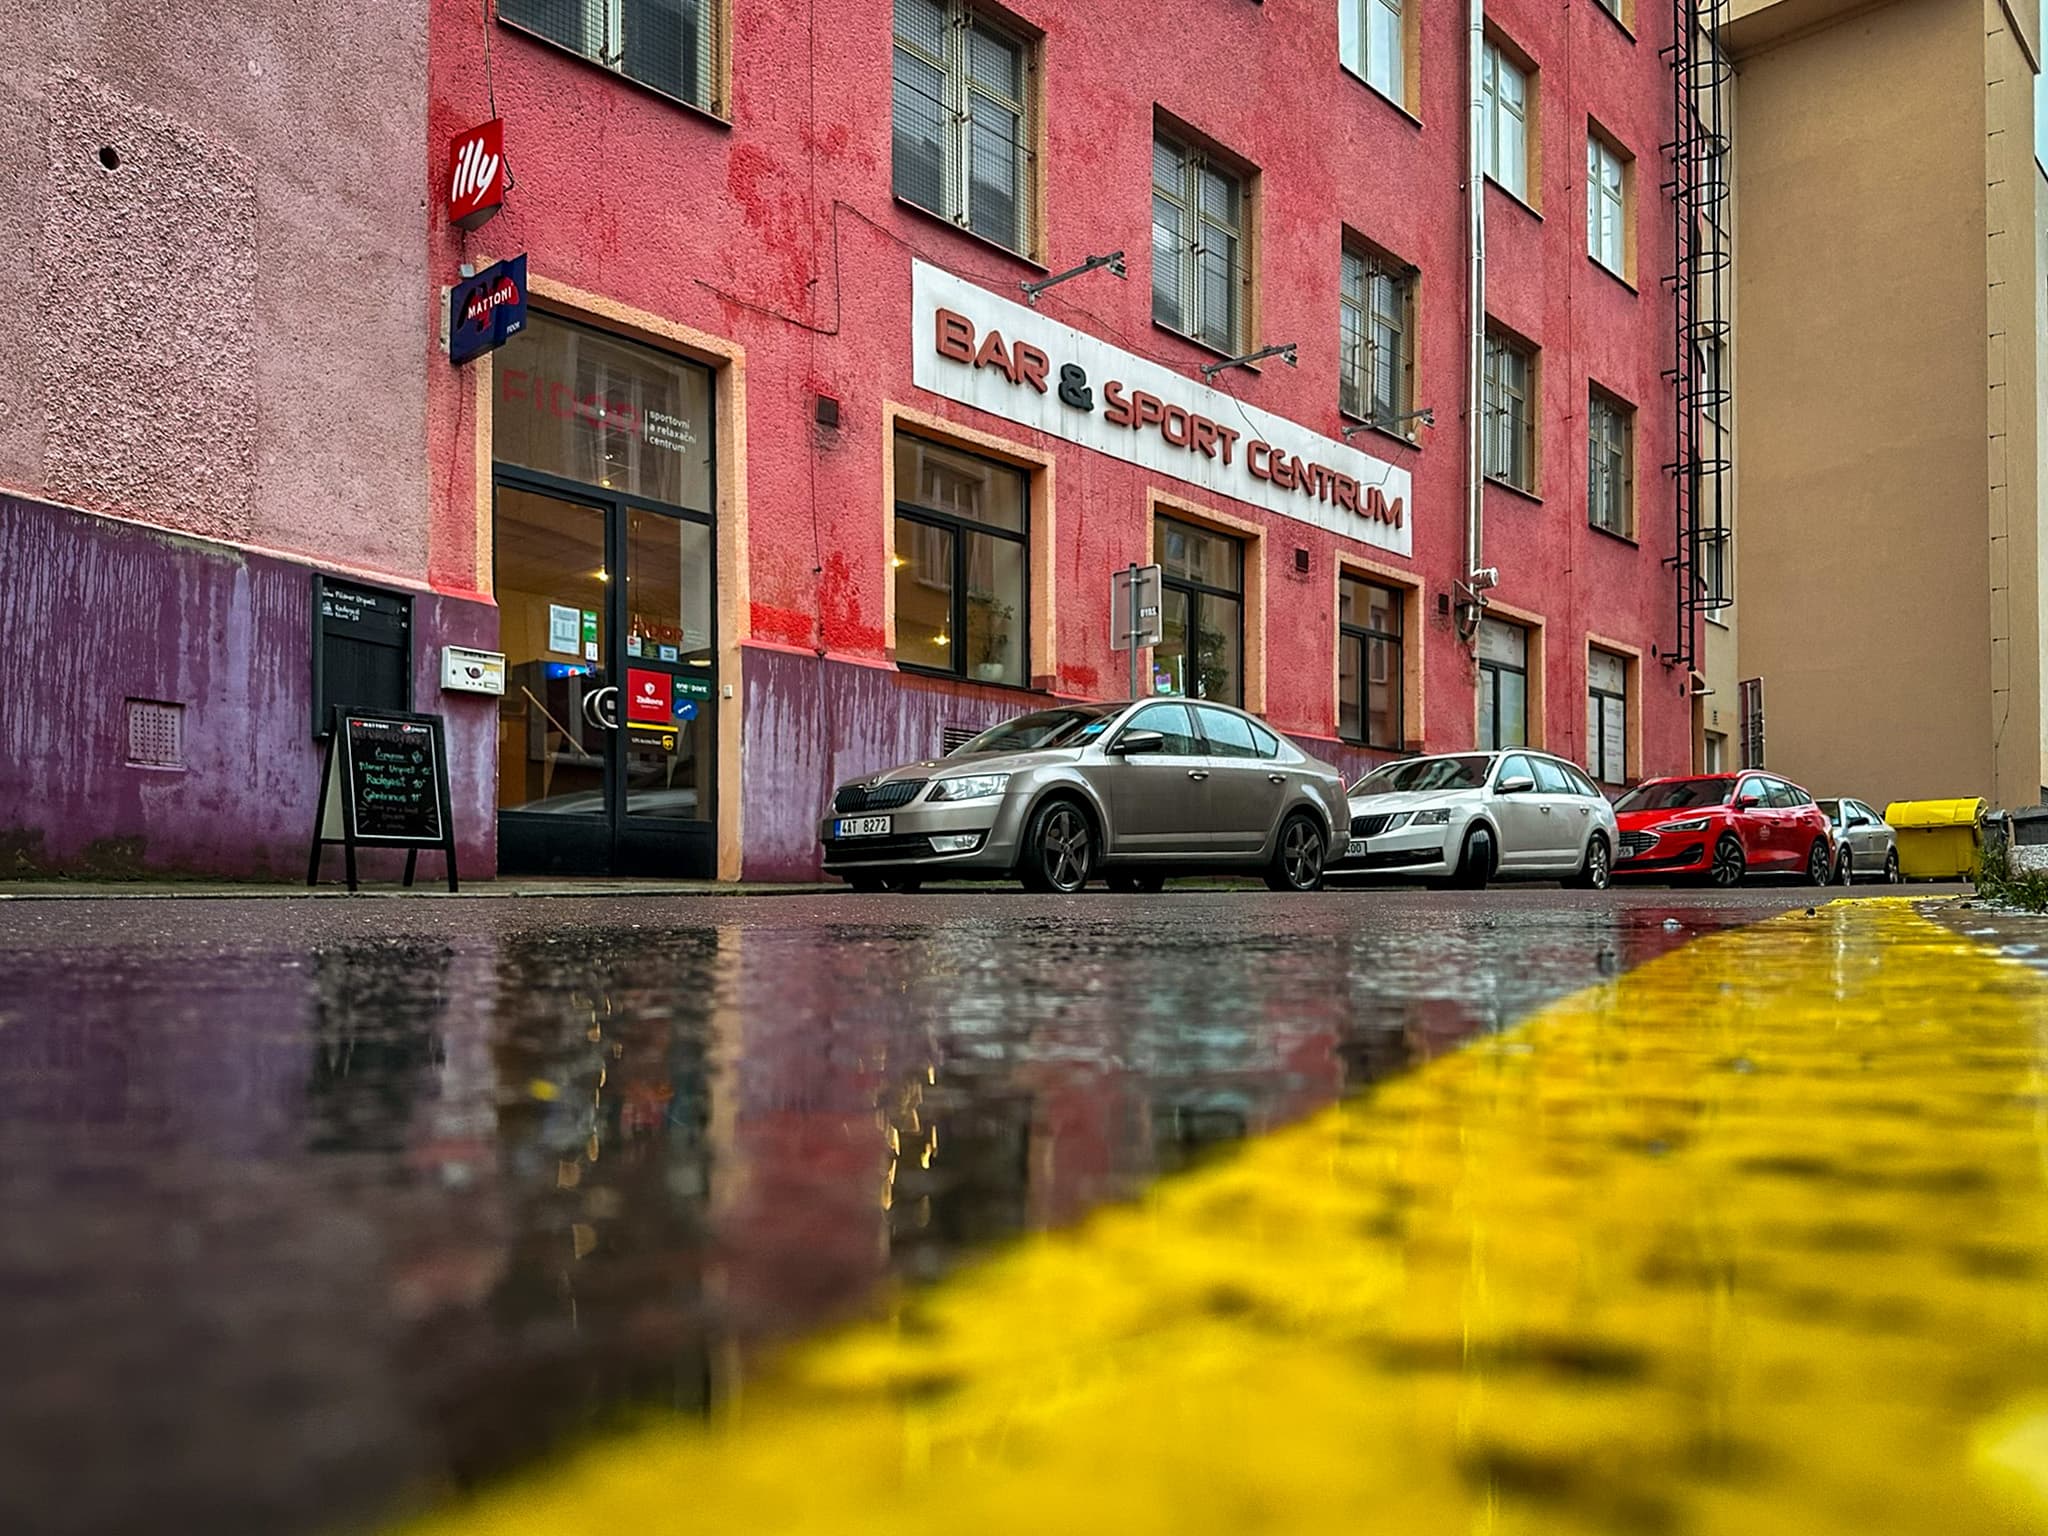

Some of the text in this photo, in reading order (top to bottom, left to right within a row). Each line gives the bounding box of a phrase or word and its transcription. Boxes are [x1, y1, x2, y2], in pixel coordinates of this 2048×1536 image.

[452, 137, 499, 206] illy
[468, 286, 512, 320] MATTONI
[649, 410, 690, 430] sportovní
[936, 307, 1403, 530] BAR & SPORT CENTRUM
[649, 423, 697, 445] a relaxační
[649, 435, 686, 454] centrum
[842, 818, 887, 834] 4AT 8272
